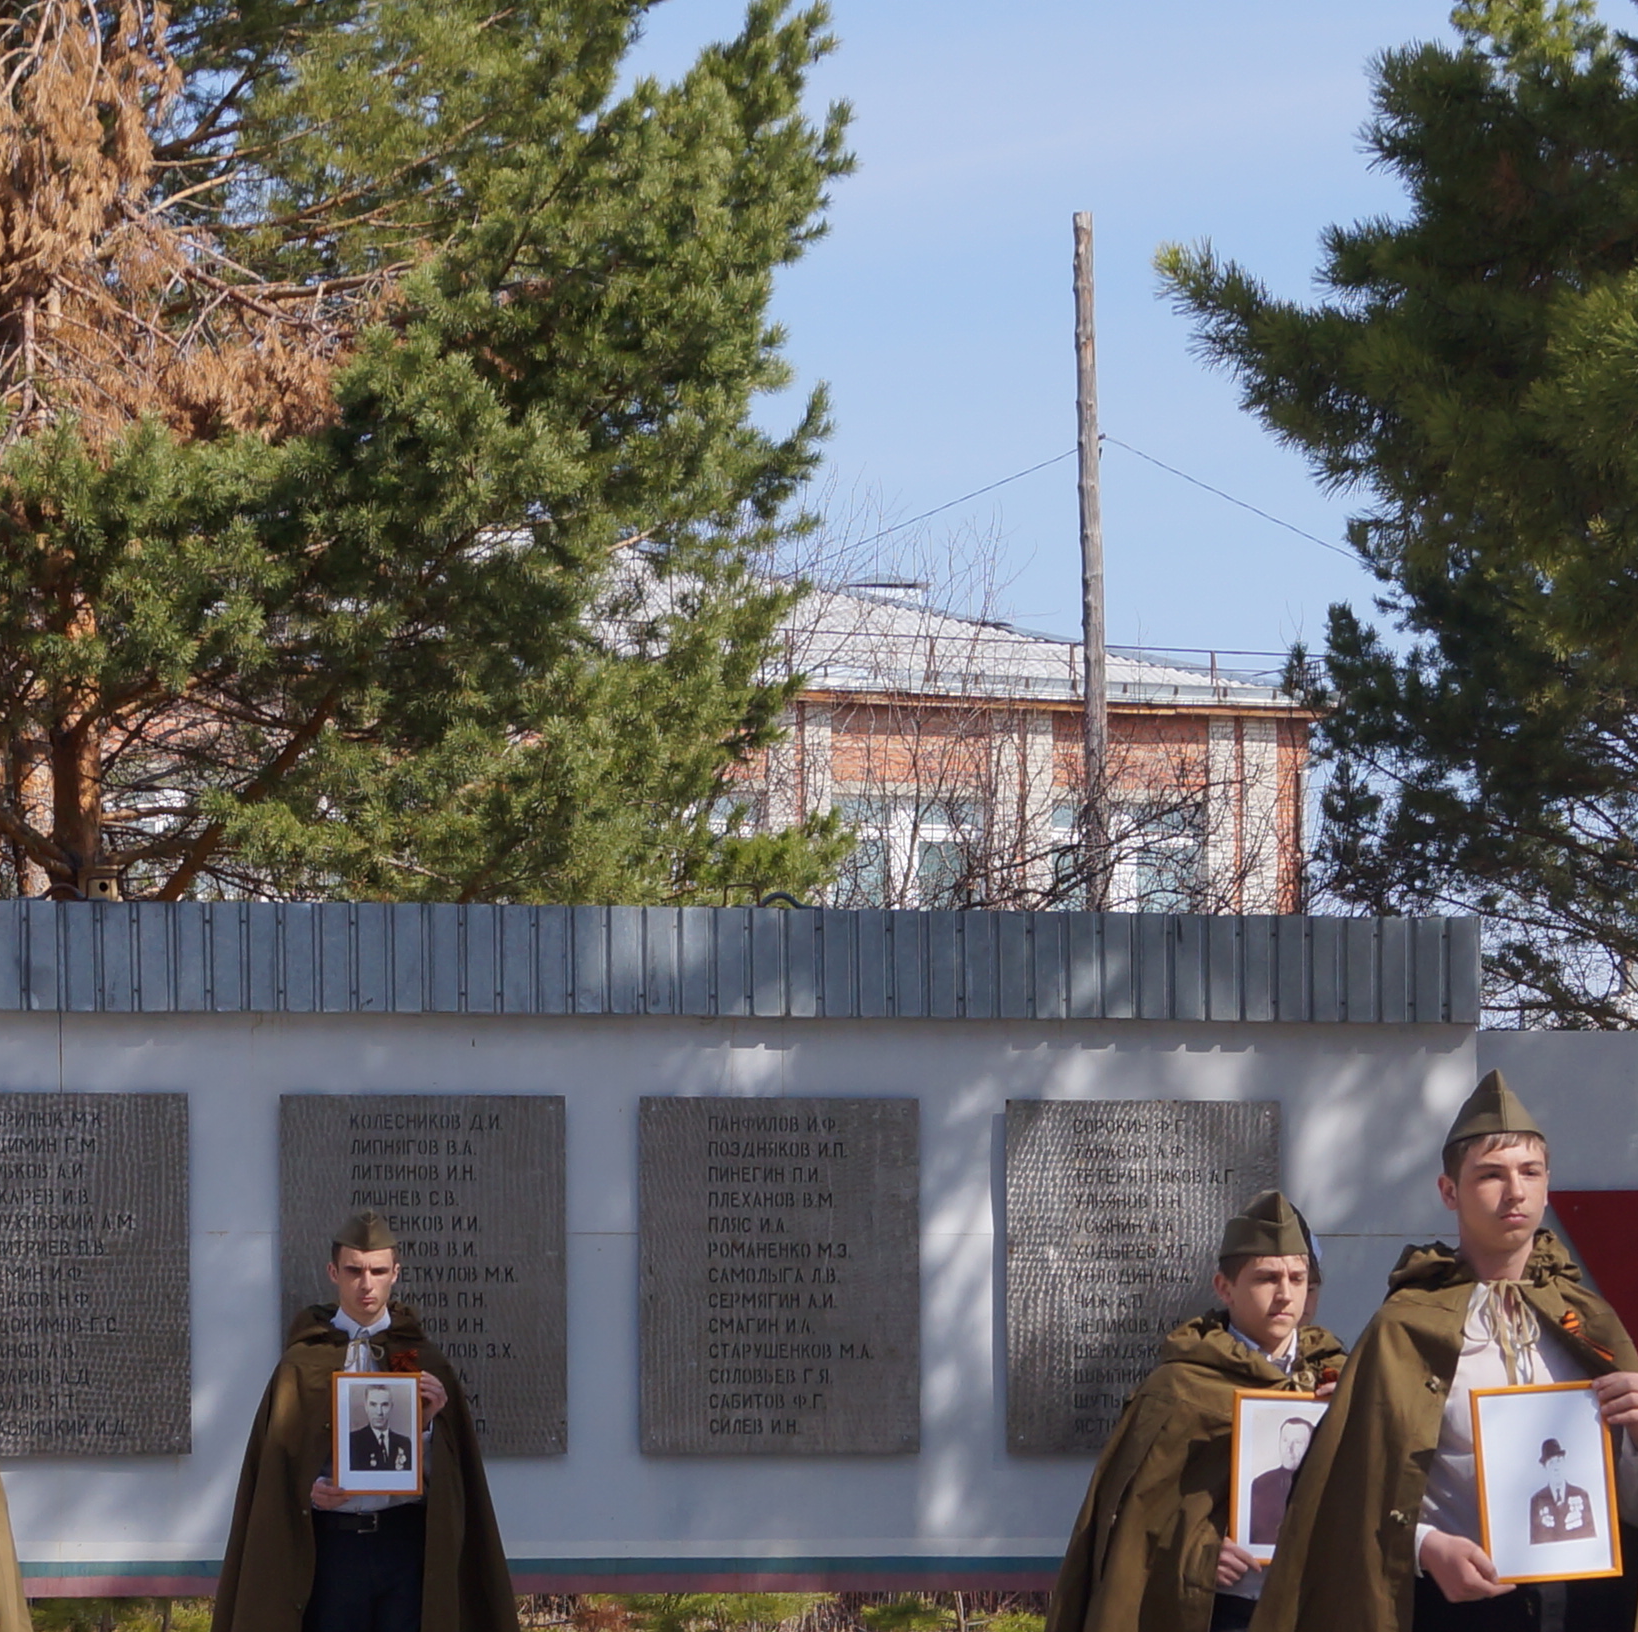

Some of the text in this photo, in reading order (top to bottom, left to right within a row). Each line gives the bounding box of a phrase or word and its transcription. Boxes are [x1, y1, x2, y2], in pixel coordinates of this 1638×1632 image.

[350, 1114, 503, 1131] КОЛЕСНИКОВ Д.И.
[708, 1116, 840, 1132] ПАНФИЛОВ И.Ф.
[1073, 1119, 1148, 1135] СОРОКИН
[350, 1140, 477, 1155] ЛИПНЯГОВ В.А.
[708, 1141, 848, 1158] ПОЗДНЯКОВ И.П.
[1073, 1144, 1147, 1159] ТАРАСОВ
[351, 1165, 477, 1181] ЛИТВИНОВ И.Н.
[708, 1167, 822, 1183] ПИНЕГИН П.И.
[1210, 1169, 1238, 1185] А.Г.
[351, 1191, 459, 1206] ЛИШНЕВ С.В.
[708, 1192, 837, 1208] ПЛЕХАНОВ В.М.
[1074, 1194, 1147, 1209] УЛЬЯНОВ
[384, 1216, 482, 1232] ЕНКОВ И.И.
[708, 1218, 789, 1233] ПЛЯС И.А.
[447, 1241, 477, 1257] В.И.
[708, 1243, 851, 1258] РОМАНЕНКО М.З.
[1075, 1244, 1156, 1260] ХОДЫРЕВ
[401, 1267, 518, 1282] ЕТКУЛОВ М.К.
[708, 1268, 841, 1283] САМОЛЫГА Л.В.
[457, 1293, 487, 1308] П.Н.
[708, 1293, 838, 1309] СЕРМЯГИН А.И.
[457, 1318, 487, 1333] И.Н.
[709, 1318, 815, 1334] СМАГИН И.А.
[486, 1343, 517, 1359] З.Х.
[709, 1343, 874, 1359] СТАРУШЕНКОВ М.А.
[1074, 1344, 1161, 1360] ШЕЛУДЯК
[709, 1368, 833, 1384] СОЛОВЬЕВ Г.Я.
[709, 1394, 827, 1410] САБИТОВ Ф.Г.
[1074, 1394, 1118, 1409] ШУТЬ
[710, 1419, 800, 1435] СИЛЕВ И.Н.
[1075, 1420, 1113, 1435] ЯСТР
